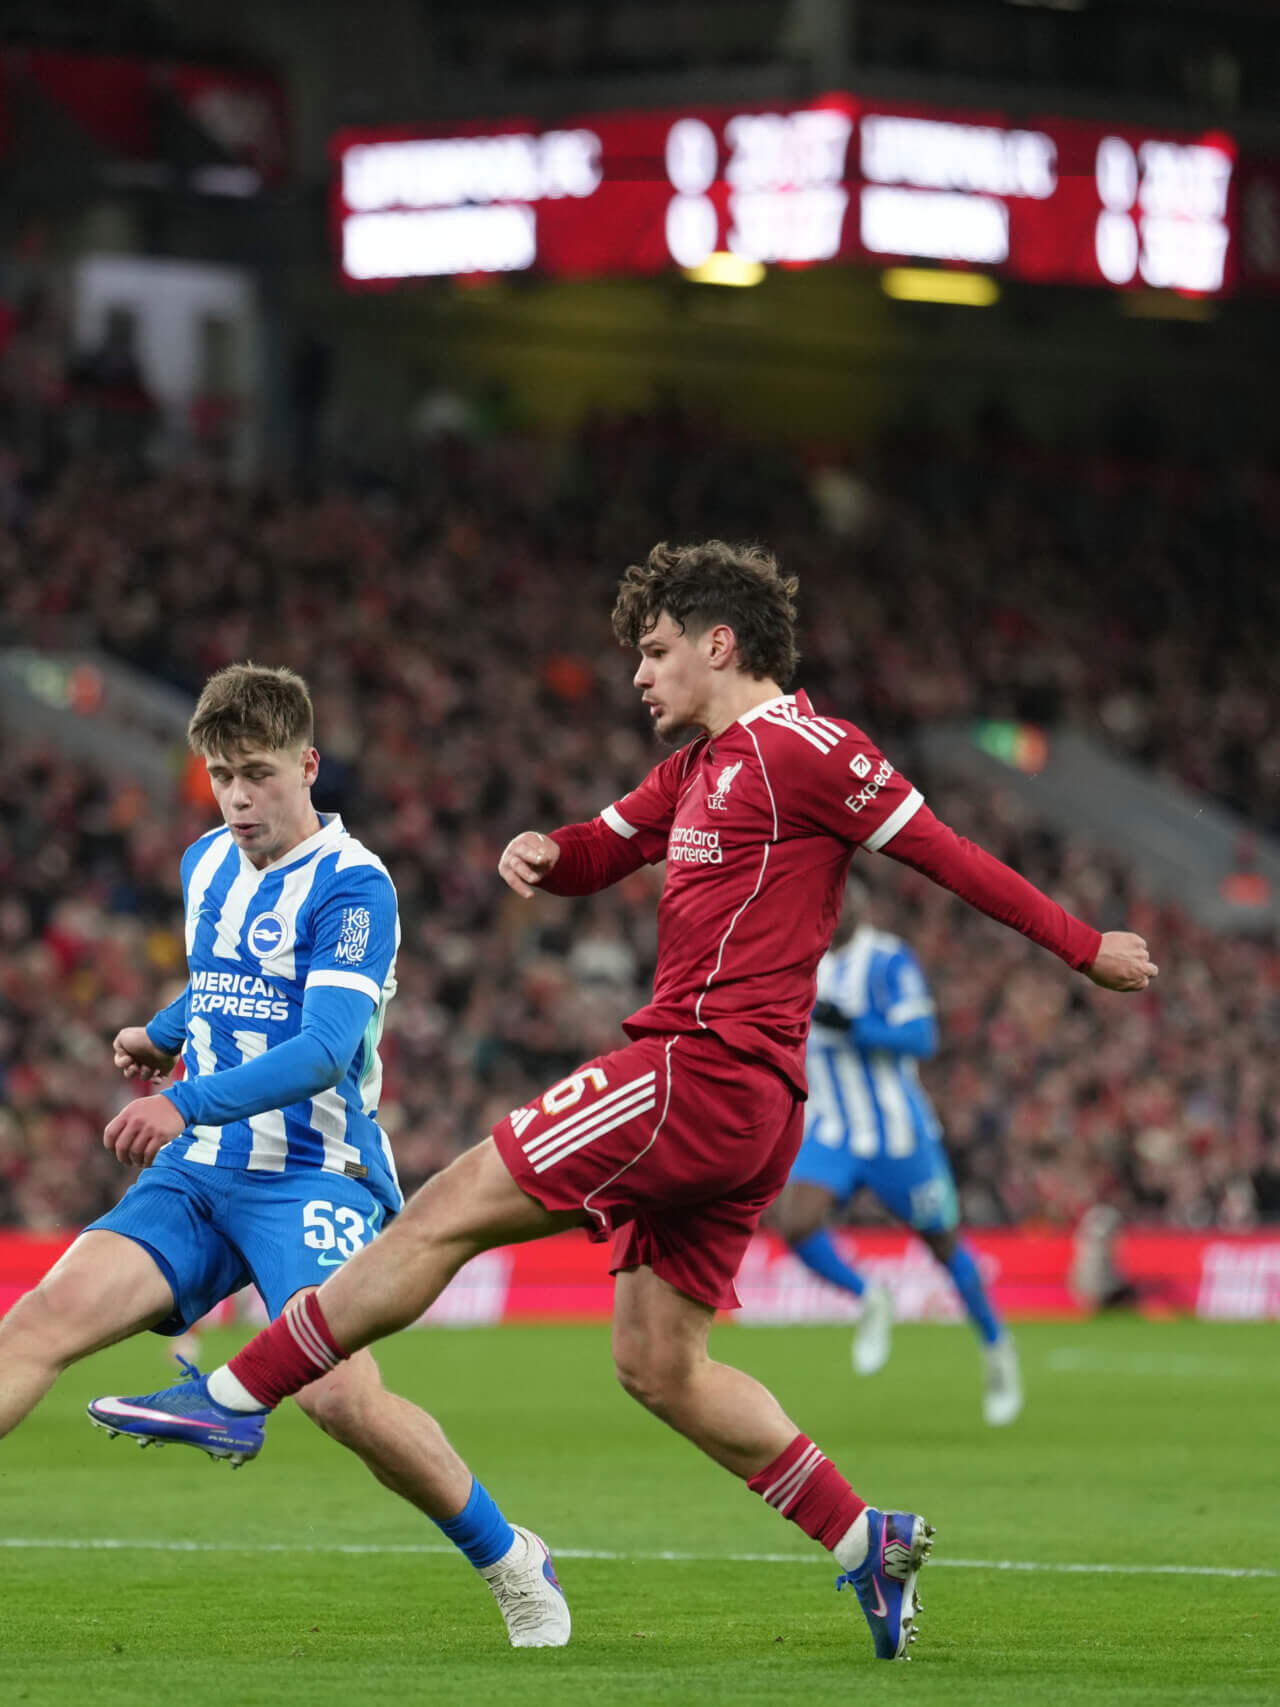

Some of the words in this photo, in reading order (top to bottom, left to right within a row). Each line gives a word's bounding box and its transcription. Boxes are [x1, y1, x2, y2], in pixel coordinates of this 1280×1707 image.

[844, 759, 895, 813] Exped
[191, 971, 287, 999] MERICAN
[191, 993, 289, 1021] EXPRESS
[541, 1067, 609, 1117] 6
[303, 1200, 365, 1259] 53
